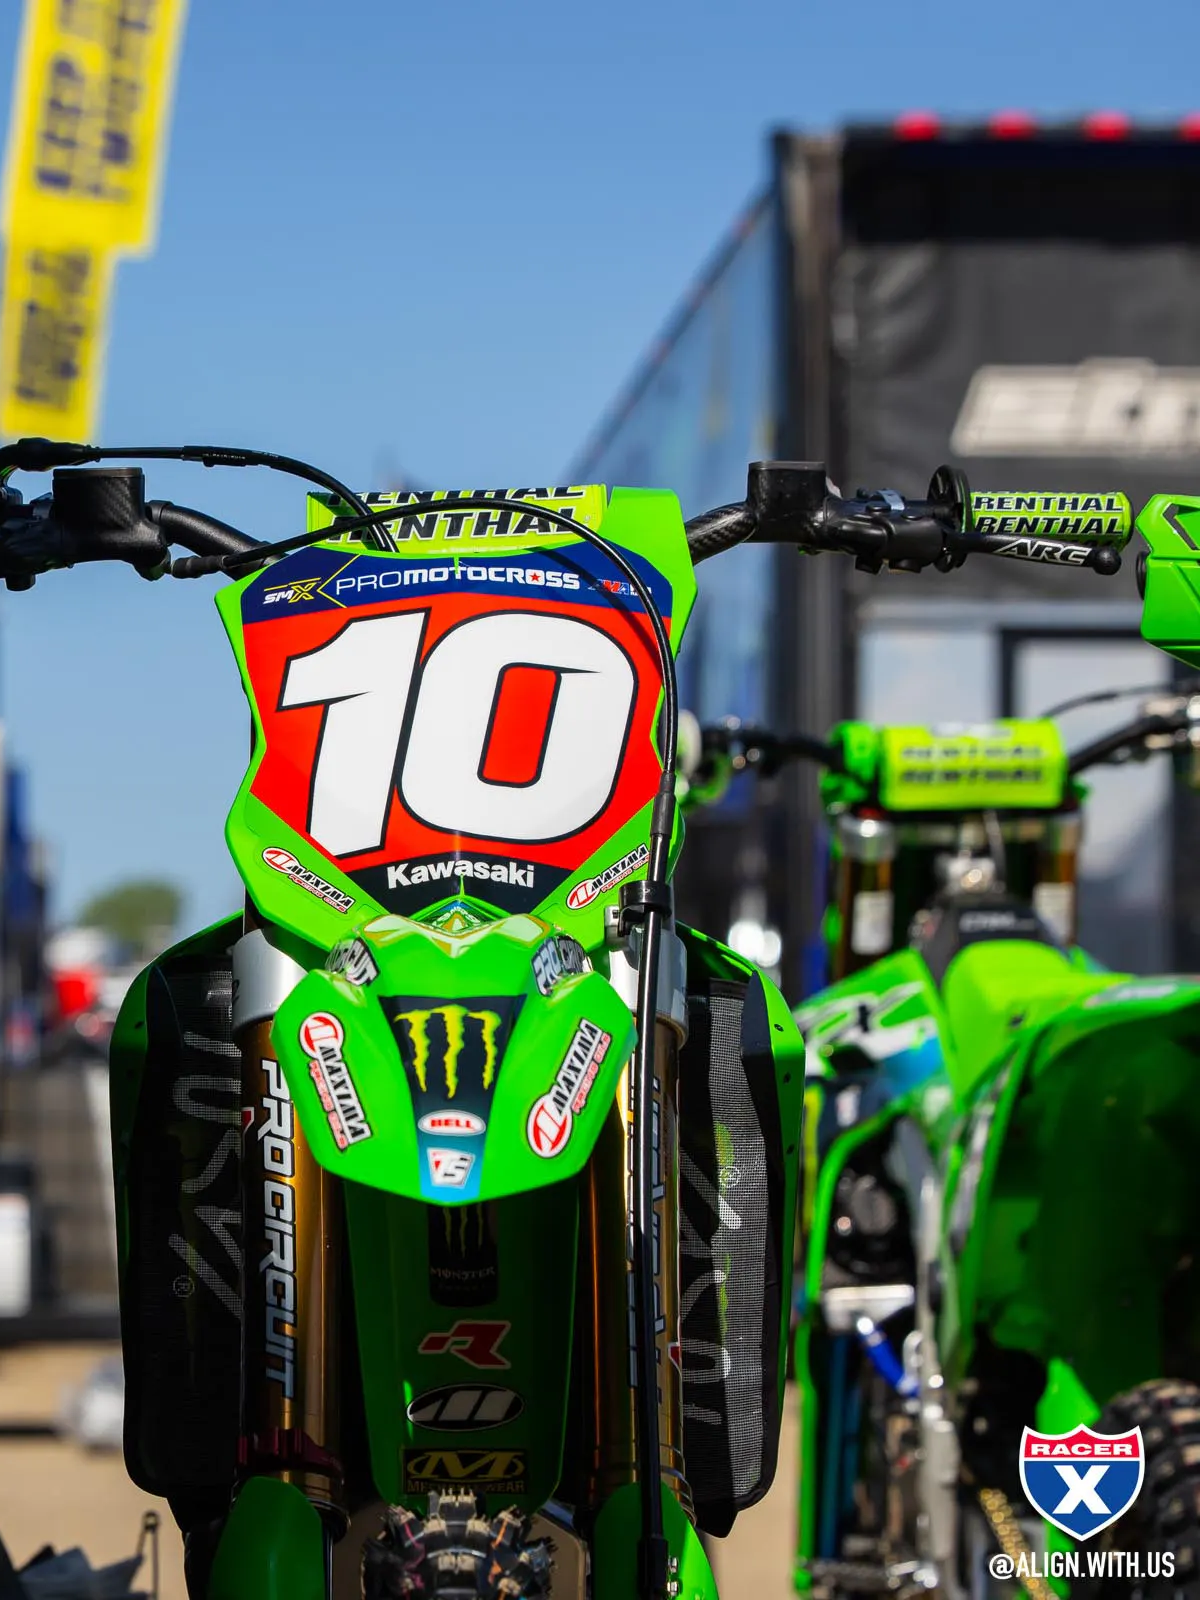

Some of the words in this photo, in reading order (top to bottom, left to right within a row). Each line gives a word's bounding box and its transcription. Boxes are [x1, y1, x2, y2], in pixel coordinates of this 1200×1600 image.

[973, 496, 1124, 512] RENTHAL
[974, 515, 1124, 535] RENTHAL
[994, 538, 1092, 567] ARC
[263, 582, 315, 605] SMX
[280, 609, 636, 858] 10
[286, 864, 353, 908] MAXIMA
[386, 860, 535, 889] Kawasaki
[590, 845, 648, 892] MAXIMA
[551, 1022, 599, 1117] MAXIMA
[319, 1045, 366, 1139] MAXIMA
[257, 1059, 293, 1177] PRO
[430, 1118, 477, 1131] BELL
[258, 1180, 295, 1399] CIRCUIT
[430, 1265, 496, 1281] MONSTER
